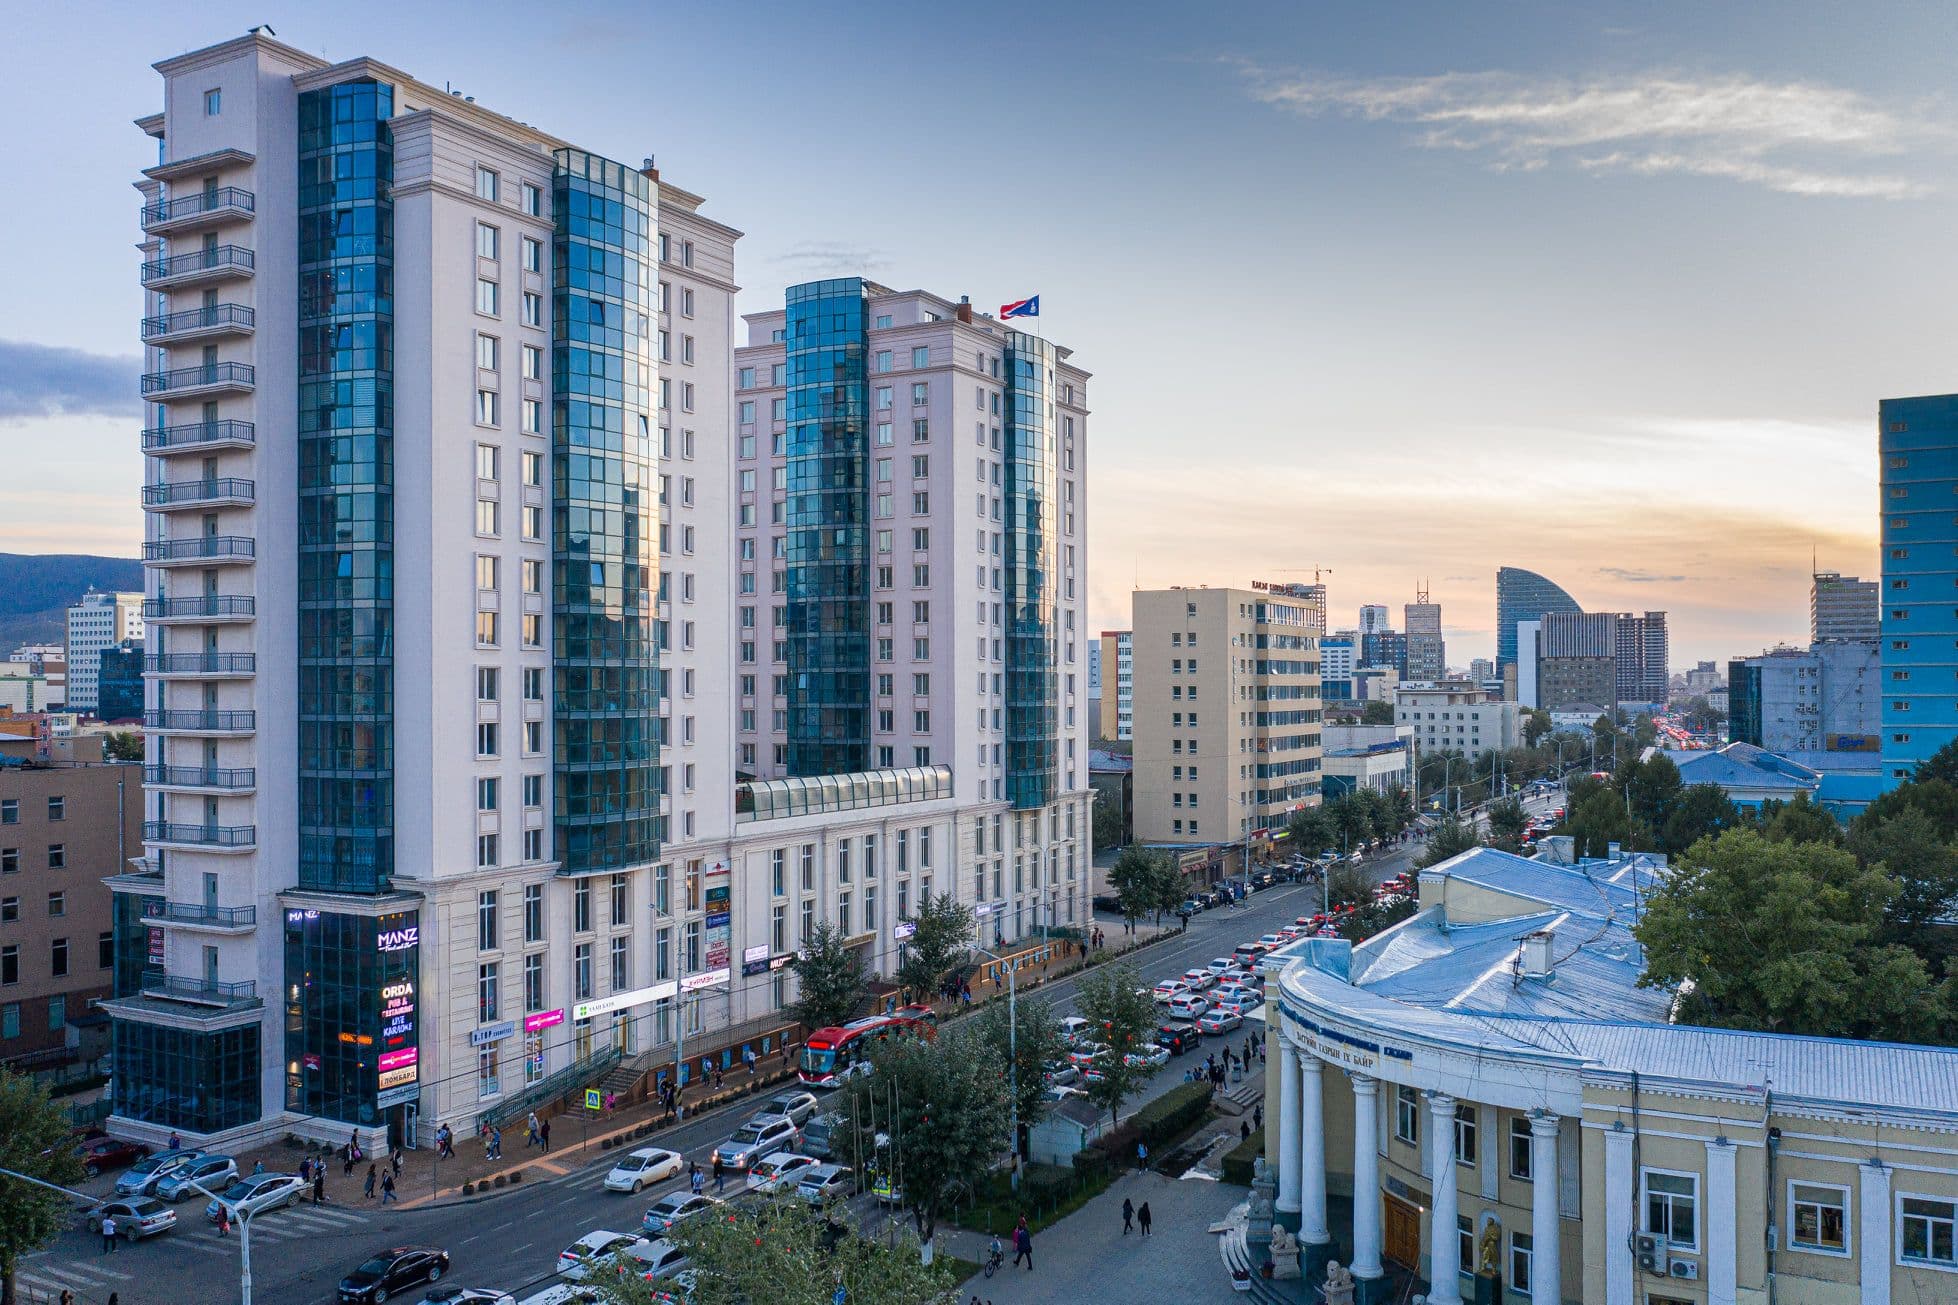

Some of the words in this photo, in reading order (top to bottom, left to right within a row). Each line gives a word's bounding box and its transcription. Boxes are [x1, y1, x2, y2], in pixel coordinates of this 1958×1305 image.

[289, 911, 318, 922] MANZ
[378, 928, 417, 946] MANZ
[382, 983, 413, 998] ORDA
[383, 1022, 413, 1037] KARAOKE
[1319, 1044, 1340, 1059] ГАЗРЫН
[1353, 1055, 1374, 1068] БАЙР
[384, 1071, 416, 1085] ЛОМБАРД
